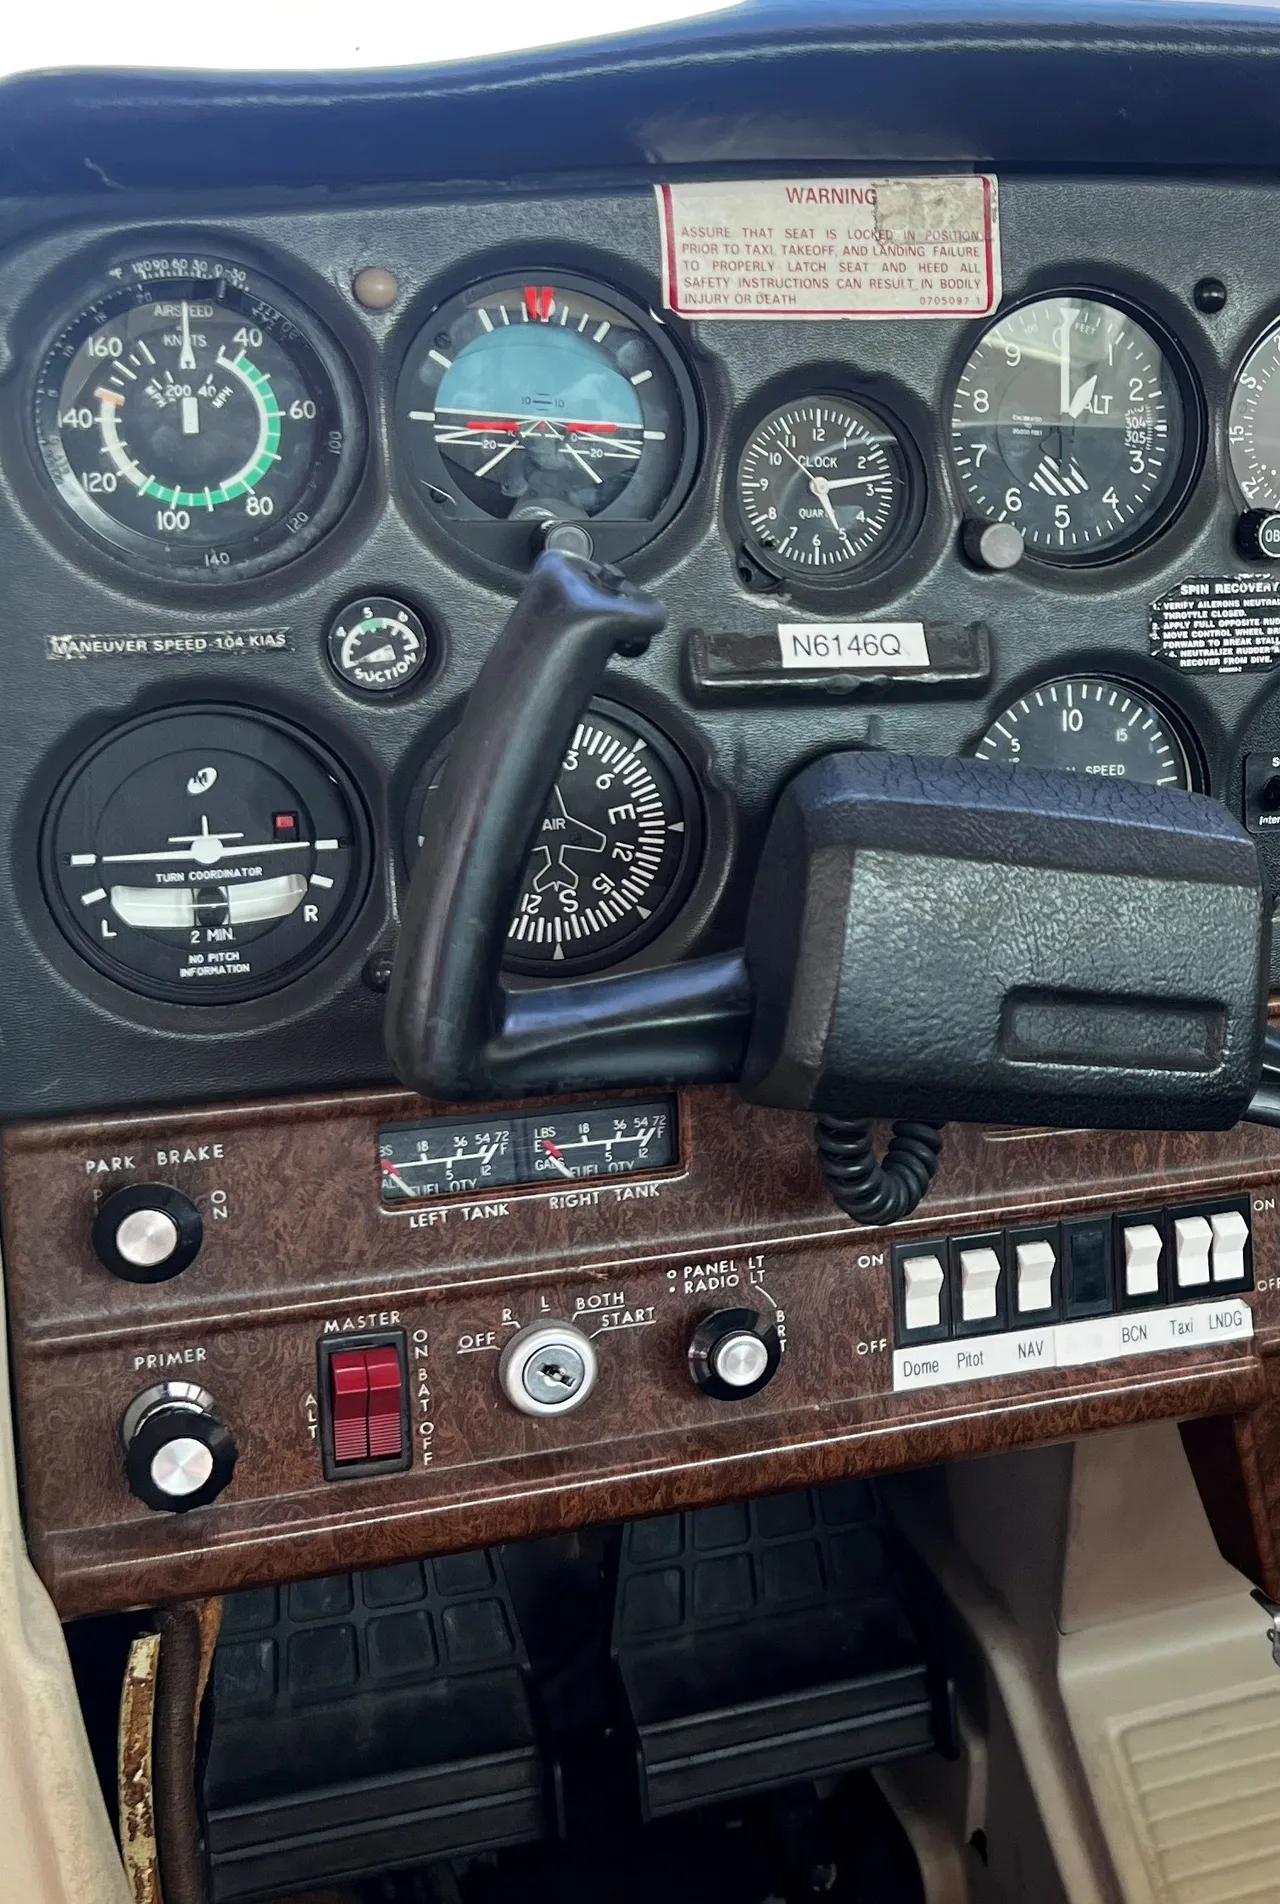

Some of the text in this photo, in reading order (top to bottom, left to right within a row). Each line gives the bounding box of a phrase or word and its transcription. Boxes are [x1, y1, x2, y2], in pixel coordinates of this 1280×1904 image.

[786, 187, 877, 205] WARNING
[682, 226, 979, 240] ASSURE THAT SEAT LOCKED POSITION
[682, 244, 718, 254] PRIOR
[724, 244, 739, 254] TO
[843, 246, 868, 256] AND
[873, 246, 925, 256] LANDING
[933, 247, 979, 257] FAILURE
[684, 260, 980, 273] TO PROPERLY LATCH SEAT AND HEED ALL
[684, 277, 981, 289] SAFETY INSTRUCTIONS CAN RESULT IN BODILY
[685, 294, 729, 304] INJURY
[735, 294, 751, 304] OR
[756, 294, 796, 304] DEATH
[234, 328, 262, 347] 40
[88, 337, 122, 358] 160
[58, 408, 93, 428] 140
[290, 399, 316, 419] 60
[798, 456, 838, 468] CLOCK
[82, 472, 117, 493] 120
[246, 496, 273, 516] 80
[157, 511, 190, 530] 100
[1181, 582, 1280, 595] SPIN RECOVERY
[1163, 602, 1194, 610] VERIFY
[1198, 600, 1240, 609] AILERONS
[1163, 611, 1208, 620] THROTTLE
[1163, 619, 1260, 630] APPLY FULL OPPOSITE
[1163, 628, 1264, 639] MOVE CONTROL WHEEL
[50, 637, 147, 656] MANEUVER
[249, 634, 286, 648] KIAS
[792, 634, 901, 656] N6146Q
[1163, 640, 1205, 649] FORWARD
[353, 652, 417, 682] SUCTION
[1180, 657, 1247, 667] RECOVER FROM
[1063, 709, 1083, 732] 10
[542, 818, 565, 831] AIR
[156, 867, 262, 883] TURN COORDINATOR
[208, 951, 239, 962] PITCH
[180, 963, 250, 977] INFORMATION
[85, 1144, 224, 1174] PARK BRAKE
[550, 1184, 660, 1209] RIGHT TANK
[1253, 1199, 1276, 1212] ON
[410, 1204, 509, 1228] LEFT TANK
[683, 1255, 764, 1279] PANEL LT
[858, 1253, 884, 1268] ON
[684, 1270, 765, 1294] RADIO LT
[576, 1292, 625, 1310] BOTH
[324, 1311, 401, 1333] MASTER
[602, 1307, 655, 1327] START
[459, 1331, 496, 1348] OFF
[857, 1339, 887, 1356] OFF
[903, 1310, 1243, 1377] Dome Pitot NAV BCN Taxi LNDG
[134, 1347, 207, 1371] PRIMER
